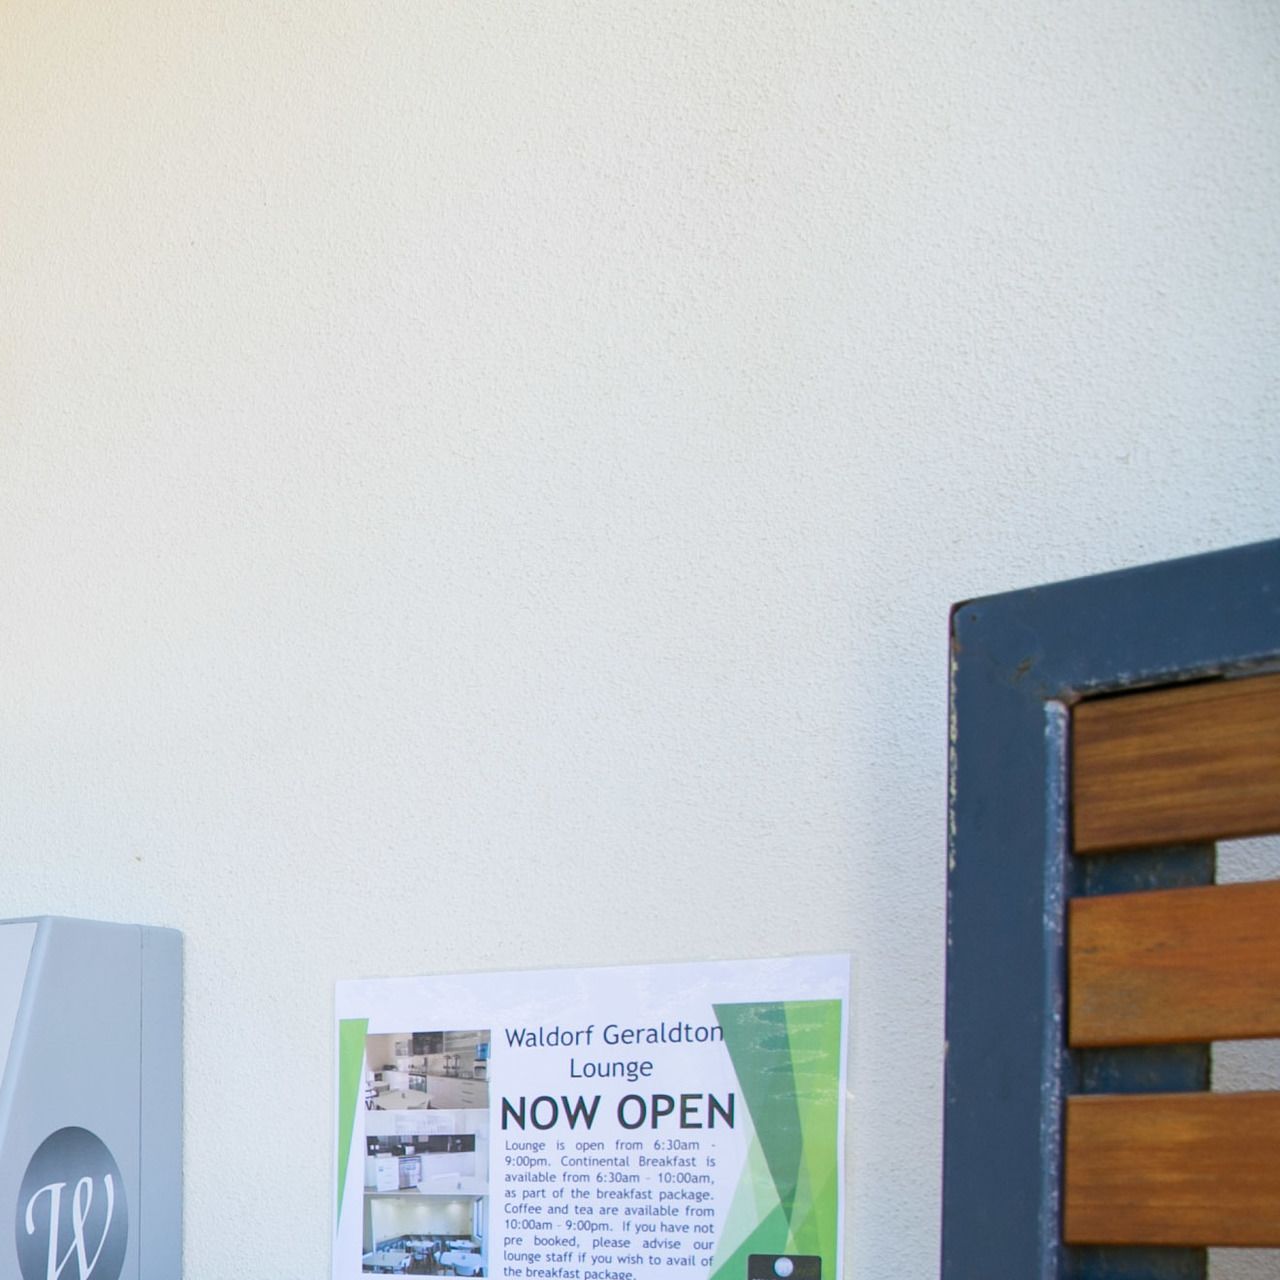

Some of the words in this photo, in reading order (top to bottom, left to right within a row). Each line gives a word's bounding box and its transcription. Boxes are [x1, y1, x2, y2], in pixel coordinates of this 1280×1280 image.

[505, 1026, 593, 1047] Waldorf
[603, 1023, 724, 1045] Geraldton
[570, 1058, 654, 1081] Lounge
[502, 1096, 600, 1130] NOW
[617, 1093, 735, 1130] OPEN
[505, 1141, 546, 1151] Lounge
[557, 1141, 565, 1150] is
[576, 1142, 604, 1154] open
[616, 1140, 643, 1150] from
[654, 1140, 699, 1150] 6:30am
[505, 1157, 551, 1169] 9:00pm.
[561, 1156, 629, 1167] Continental
[640, 1157, 696, 1167] Breakfast
[707, 1157, 715, 1167] is
[505, 1173, 556, 1183] available
[563, 1172, 590, 1183] from
[597, 1173, 640, 1183] 6:30am
[658, 1173, 714, 1185] 10:00am,
[505, 1190, 516, 1198] as
[523, 1190, 546, 1201] part
[552, 1188, 564, 1199] of
[571, 1189, 590, 1199] the
[597, 1189, 652, 1199] breakfast
[659, 1190, 714, 1202] package.
[505, 1203, 542, 1214] Coffee
[548, 1204, 568, 1214] and
[575, 1206, 593, 1215] tea
[600, 1207, 618, 1216] are
[625, 1205, 679, 1216] available
[686, 1205, 715, 1217] from
[505, 1219, 552, 1230] 10:00am
[566, 1220, 613, 1232] 9:00pm.
[623, 1222, 630, 1231] If
[636, 1224, 656, 1234] you
[661, 1223, 689, 1233] have
[694, 1224, 714, 1234] not
[504, 1237, 523, 1248] pre
[534, 1236, 579, 1247] booked,
[593, 1237, 631, 1250] please
[643, 1239, 681, 1249] advise
[694, 1241, 714, 1250] our
[504, 1251, 541, 1263] lounge
[546, 1252, 572, 1262] staff
[579, 1252, 587, 1262] if
[592, 1254, 612, 1265] you
[618, 1254, 643, 1265] wish
[649, 1256, 661, 1265] to
[667, 1255, 696, 1266] avail
[701, 1255, 714, 1267] of
[504, 1267, 522, 1277] the
[526, 1268, 579, 1279] breakfast
